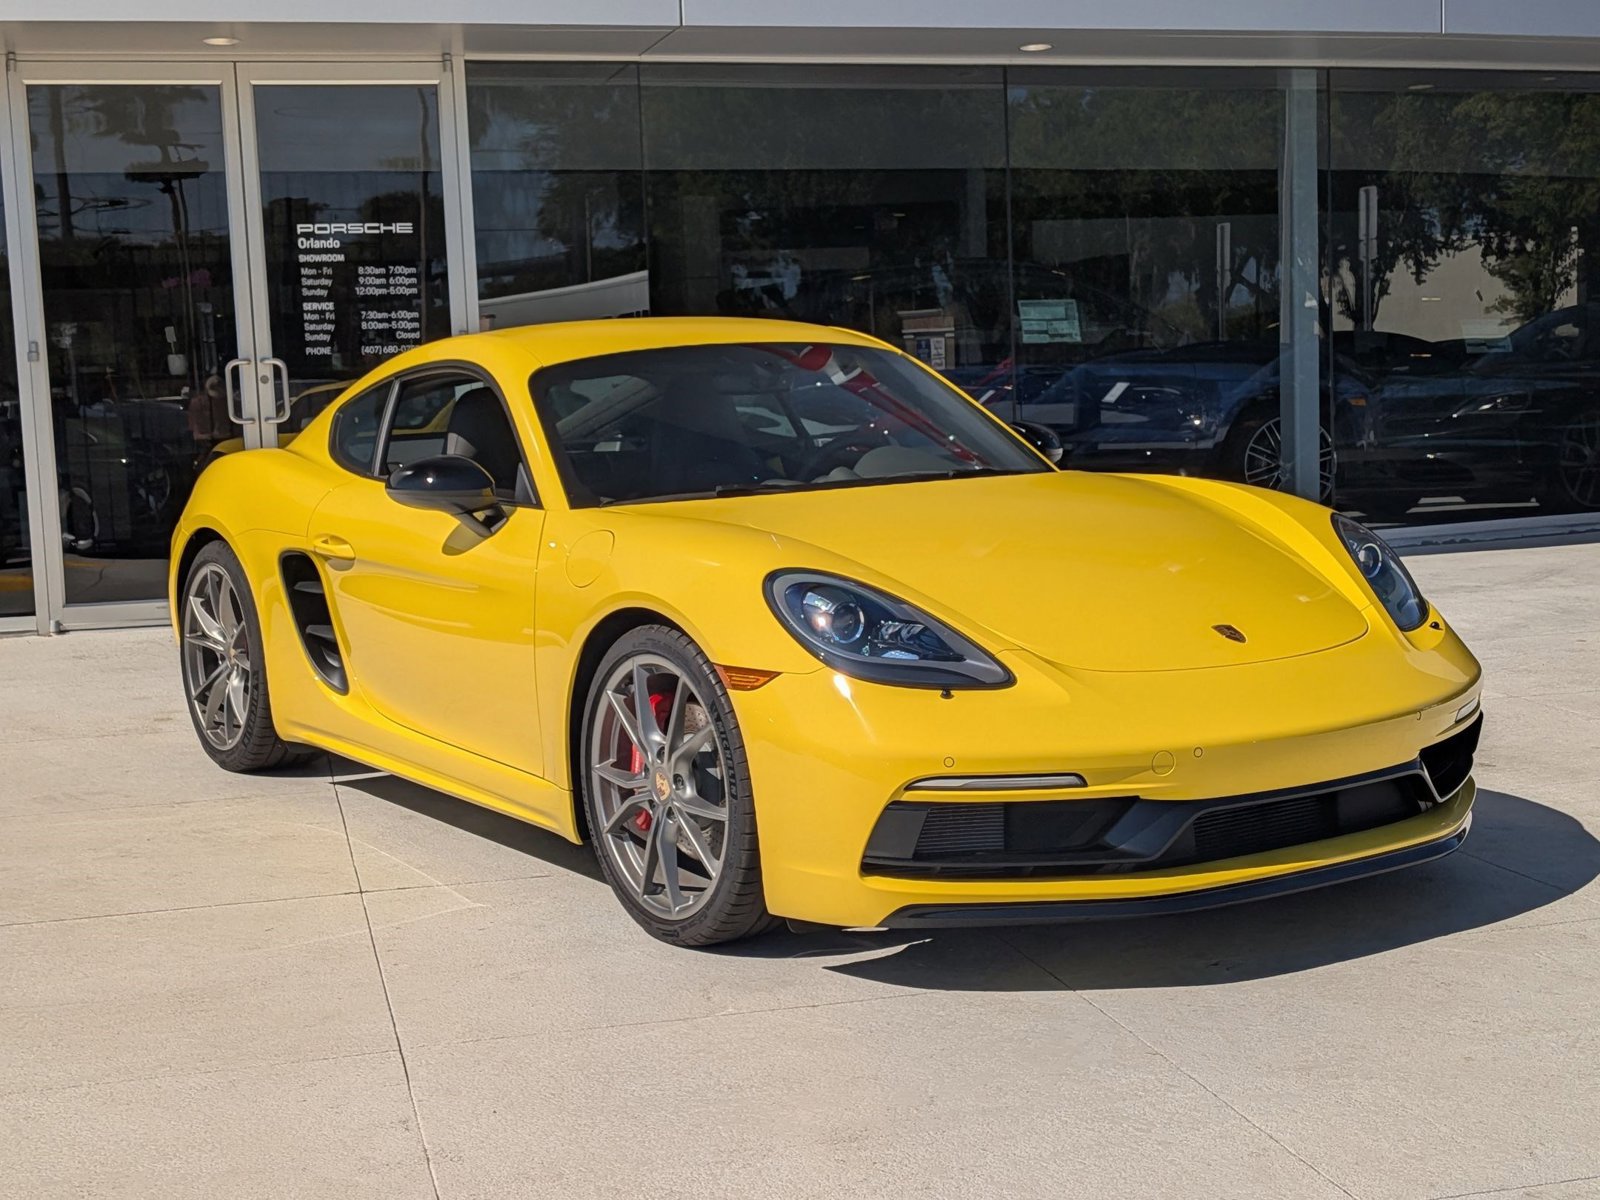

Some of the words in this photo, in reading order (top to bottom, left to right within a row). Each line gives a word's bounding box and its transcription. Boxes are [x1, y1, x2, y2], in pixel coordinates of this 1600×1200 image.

[296, 222, 413, 235] PORSCHE
[297, 237, 341, 249] Orlando
[298, 254, 345, 262] SHOWROOM
[301, 267, 318, 275] Mon
[322, 267, 333, 275] Fri
[358, 266, 386, 275] 8:30am
[388, 266, 416, 275] 7:00pm
[301, 277, 333, 287] Saturday
[358, 276, 387, 285] 9:00am
[389, 276, 417, 286] 6:00pm
[301, 288, 328, 297] Sunday
[302, 302, 335, 311] SERVICE
[303, 312, 320, 320] Mon
[325, 312, 335, 320] Fri
[304, 322, 335, 332] Saturday
[304, 333, 331, 342] Sunday
[396, 331, 420, 339] Closed
[306, 346, 332, 355] PHONE
[361, 345, 382, 355] (407)
[716, 720, 738, 795] MICHELIN
